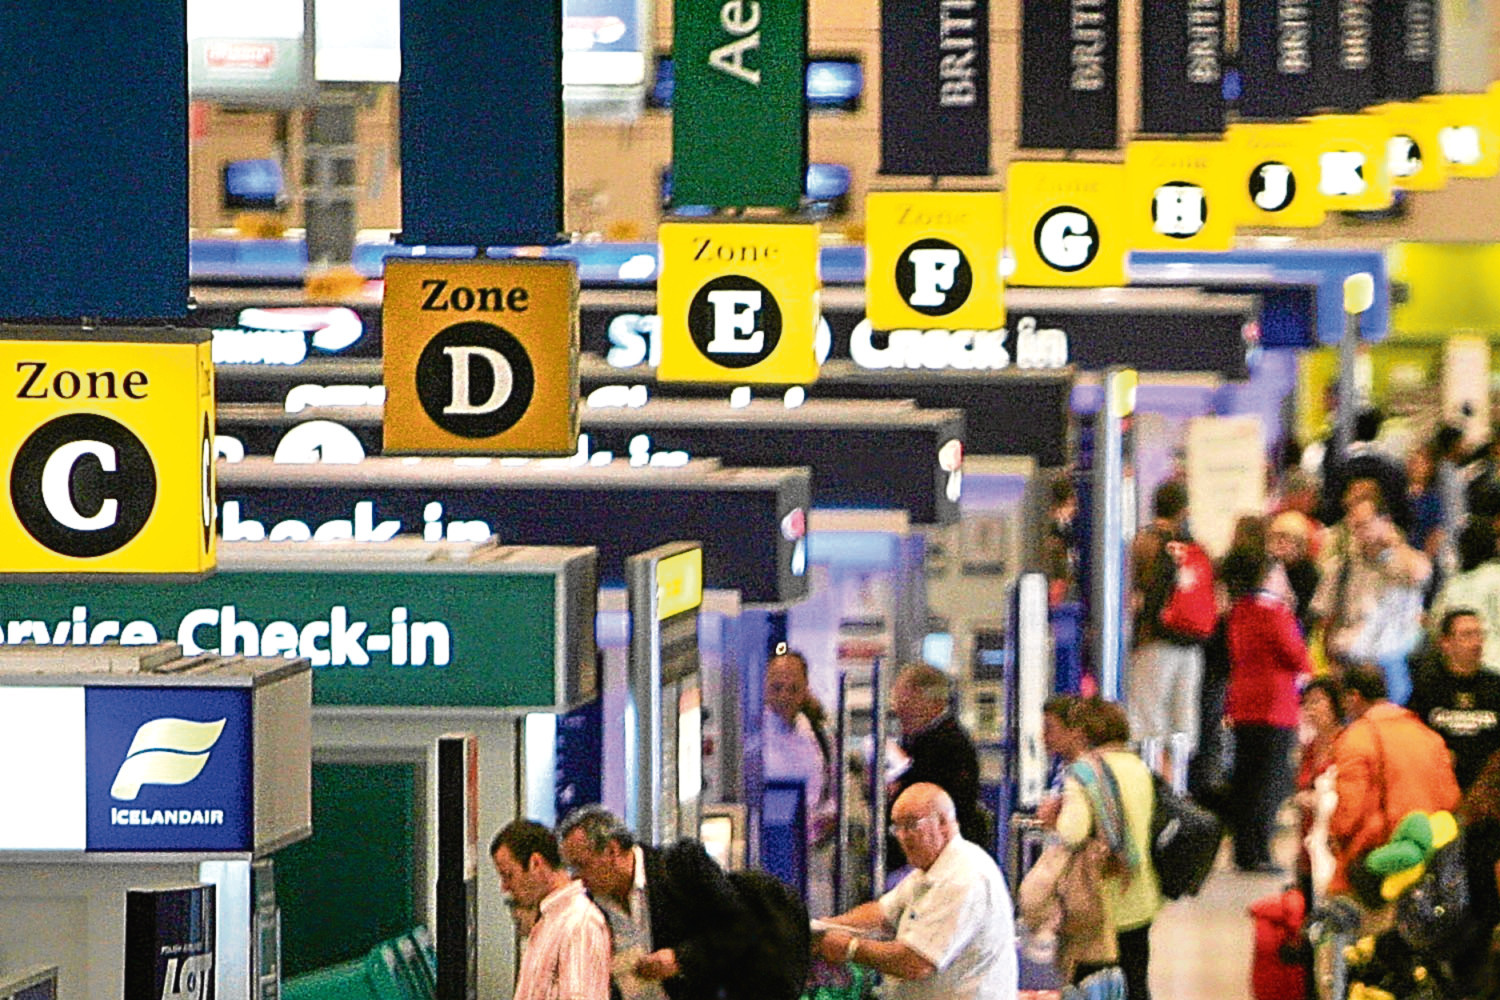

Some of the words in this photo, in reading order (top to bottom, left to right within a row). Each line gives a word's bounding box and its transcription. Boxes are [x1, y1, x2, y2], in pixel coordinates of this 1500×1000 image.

[1152, 185, 1206, 234] H
[1254, 163, 1290, 210] J
[692, 236, 779, 263] Zone
[1039, 211, 1093, 267] G
[420, 278, 530, 313] Zone
[908, 248, 961, 307] F
[706, 289, 765, 354] E
[15, 361, 149, 400] Zone
[442, 345, 514, 415] D
[41, 439, 119, 532] C
[177, 605, 451, 668] Check-in
[111, 807, 225, 826] ICELANDAIR
